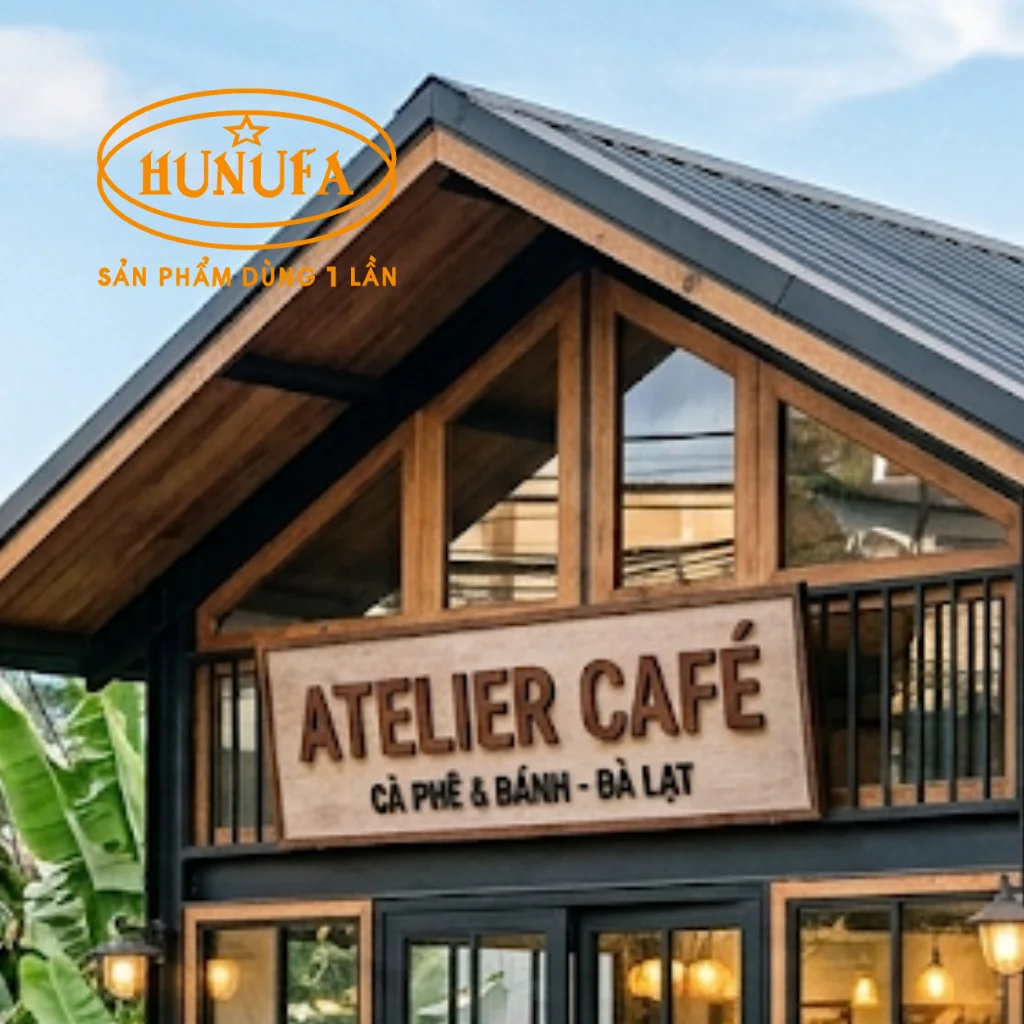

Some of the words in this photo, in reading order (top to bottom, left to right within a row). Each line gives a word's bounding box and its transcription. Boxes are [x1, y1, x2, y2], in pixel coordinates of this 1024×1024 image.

[298, 665, 561, 764] ATELIER
[579, 619, 767, 743] CAFÉ
[370, 774, 407, 815] CÀ
[411, 769, 464, 812] PHÊ
[470, 776, 489, 808] &
[495, 764, 571, 807] BÁNH
[642, 760, 695, 803] LẠT
